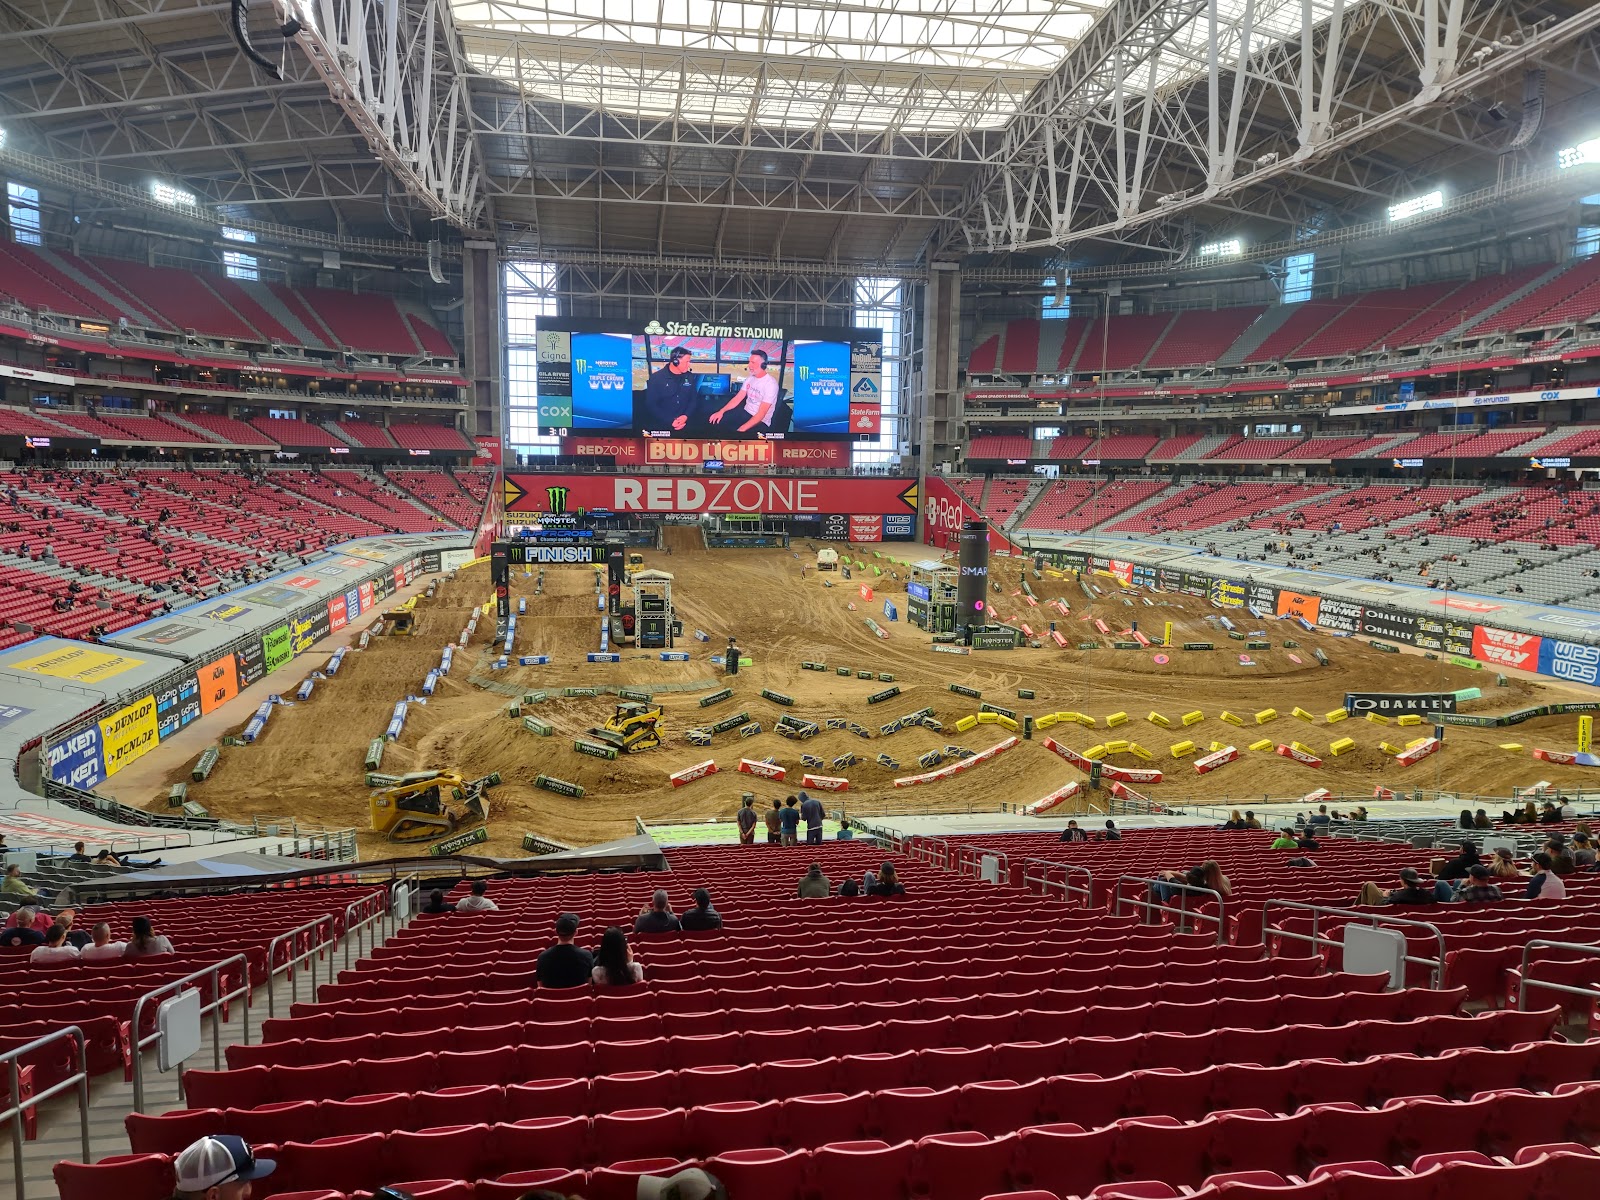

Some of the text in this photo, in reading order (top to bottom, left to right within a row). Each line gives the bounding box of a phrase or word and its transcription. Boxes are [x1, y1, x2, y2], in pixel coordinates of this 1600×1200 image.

[734, 327, 783, 339] STADIUM
[541, 351, 567, 361] Cigna
[1483, 395, 1510, 404] HYUNDAI
[1541, 391, 1559, 400] COX
[540, 406, 570, 417] COX
[549, 428, 568, 437] 3:10
[577, 445, 636, 456] REDZONE
[650, 442, 699, 460] BUD
[782, 449, 838, 459] REDZONE
[614, 478, 819, 511] REDZONE
[886, 515, 911, 524] WPS
[886, 525, 911, 534] WPS
[525, 546, 593, 562] FINISH
[1113, 560, 1131, 570] FLY
[1258, 587, 1273, 595] SPECIAL
[1258, 593, 1275, 601] WARFARE
[1256, 599, 1272, 608] SPECIAL
[1378, 612, 1415, 625] OAKLEY
[1376, 627, 1413, 640] OAKLEY
[1482, 626, 1534, 647] FLY
[1491, 641, 1520, 650] RACING
[1480, 643, 1531, 664] FLY
[1554, 640, 1600, 665] WPS
[1489, 657, 1519, 668] RACING
[212, 666, 226, 681] KTM
[1552, 659, 1598, 683] WPS
[178, 678, 198, 693] GoPro
[156, 689, 178, 704] GoPro
[214, 688, 226, 702] KTM
[181, 700, 199, 716] GoPro
[1379, 699, 1453, 709] OAKLEY
[114, 702, 152, 734] DUNLOP
[158, 713, 180, 730] GoPro
[1446, 716, 1478, 724] MONSTER
[1510, 710, 1537, 721] MONSTER
[115, 728, 154, 761] DUNLOP
[581, 744, 607, 756] MONSTER
[546, 780, 575, 794] MONSTER
[811, 779, 844, 790] FLY
[440, 834, 476, 851] MONSTER
[533, 840, 566, 853] MONSTE
